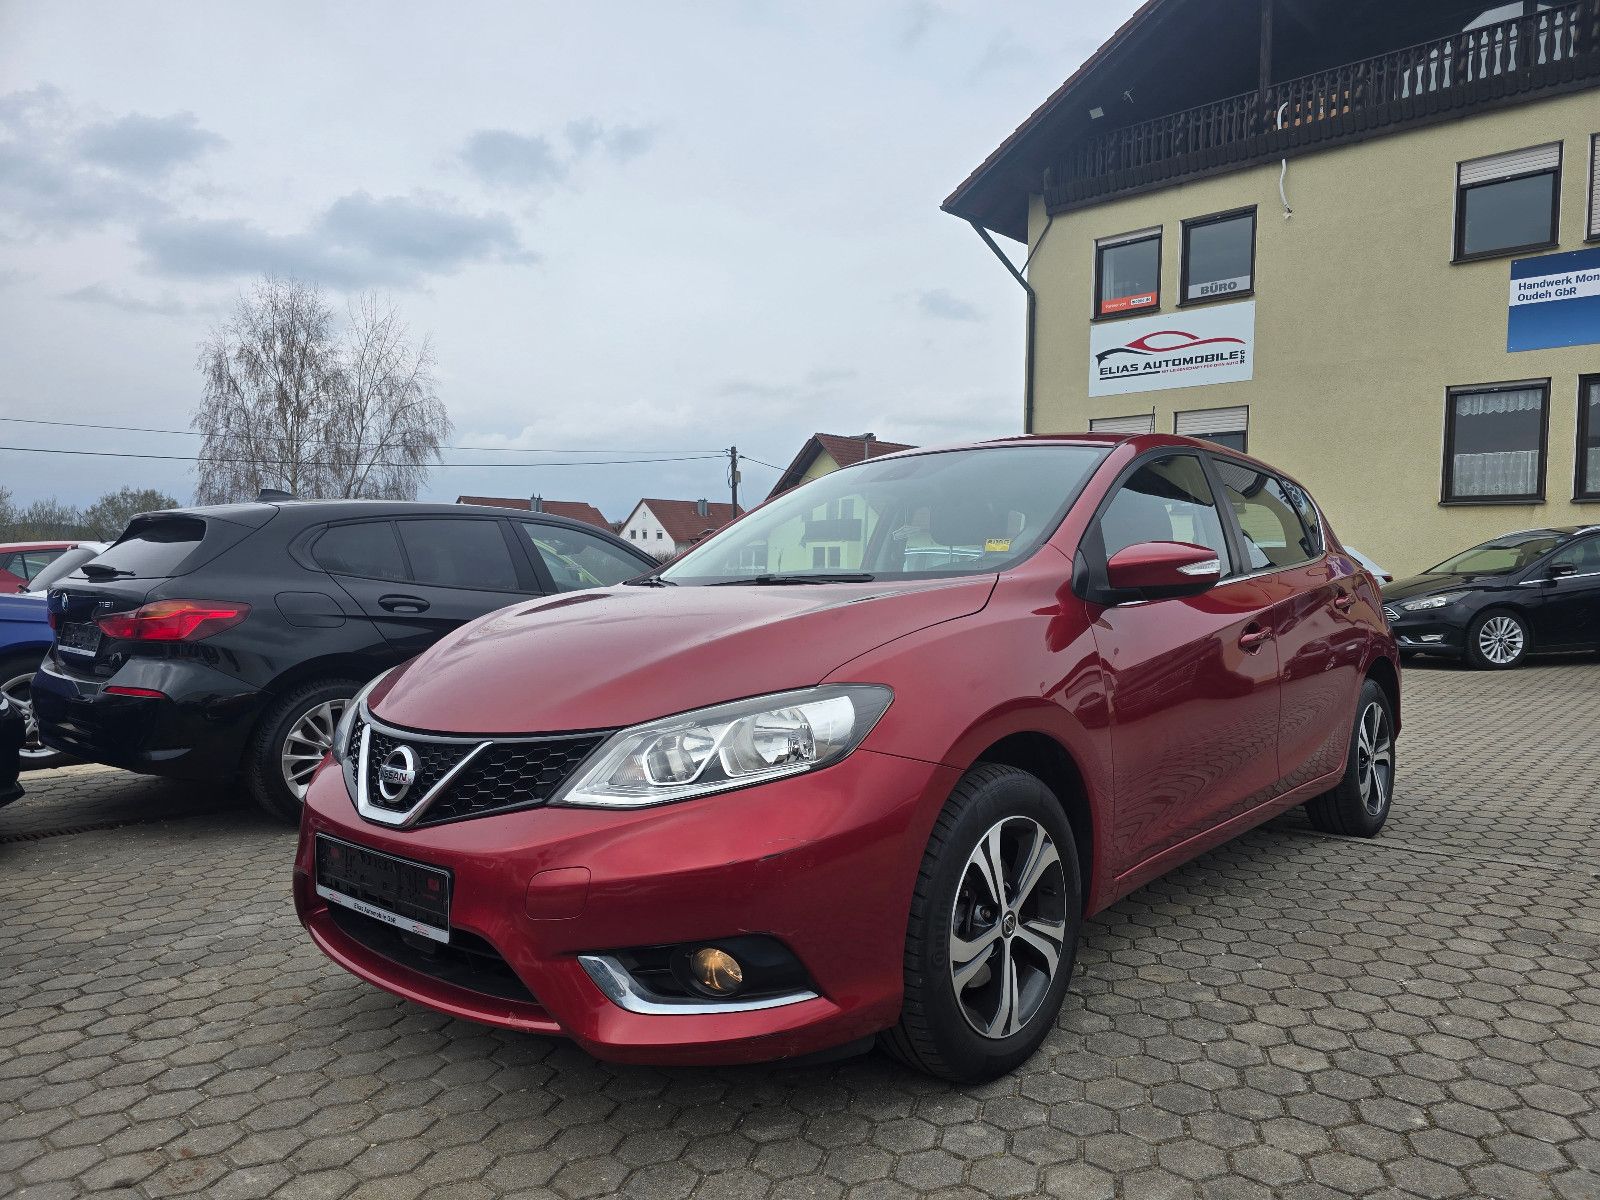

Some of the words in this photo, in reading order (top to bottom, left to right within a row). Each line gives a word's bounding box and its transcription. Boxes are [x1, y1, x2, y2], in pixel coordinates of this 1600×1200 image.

[1200, 281, 1237, 295] BÜRO
[1518, 276, 1572, 291] Handwerk
[1575, 273, 1600, 284] Mon
[1518, 290, 1552, 301] Oudeh
[1555, 286, 1577, 297] GbR
[1100, 363, 1139, 375] ELIAS
[1143, 351, 1239, 371] AUTOMOBILE
